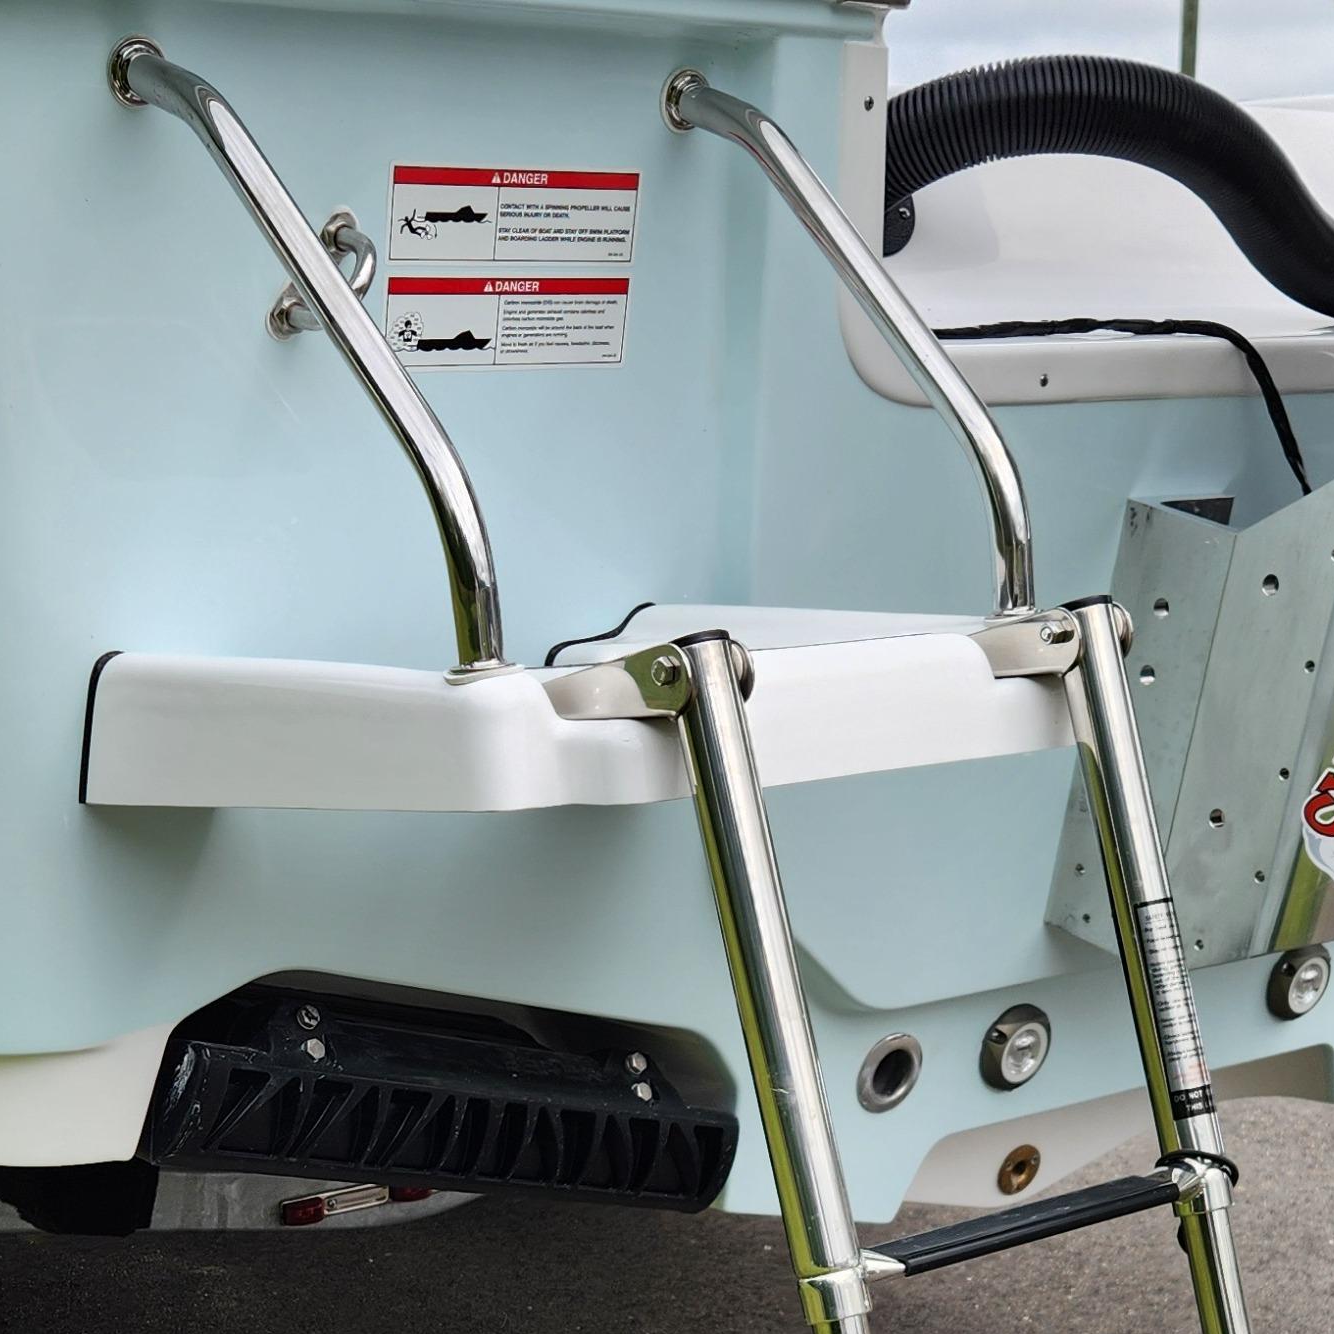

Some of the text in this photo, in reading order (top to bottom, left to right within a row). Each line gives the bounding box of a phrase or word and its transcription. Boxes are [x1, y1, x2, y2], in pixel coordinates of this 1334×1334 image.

[502, 172, 548, 185] DANGER
[495, 281, 540, 293] DANGER
[1188, 1089, 1203, 1099] NOT
